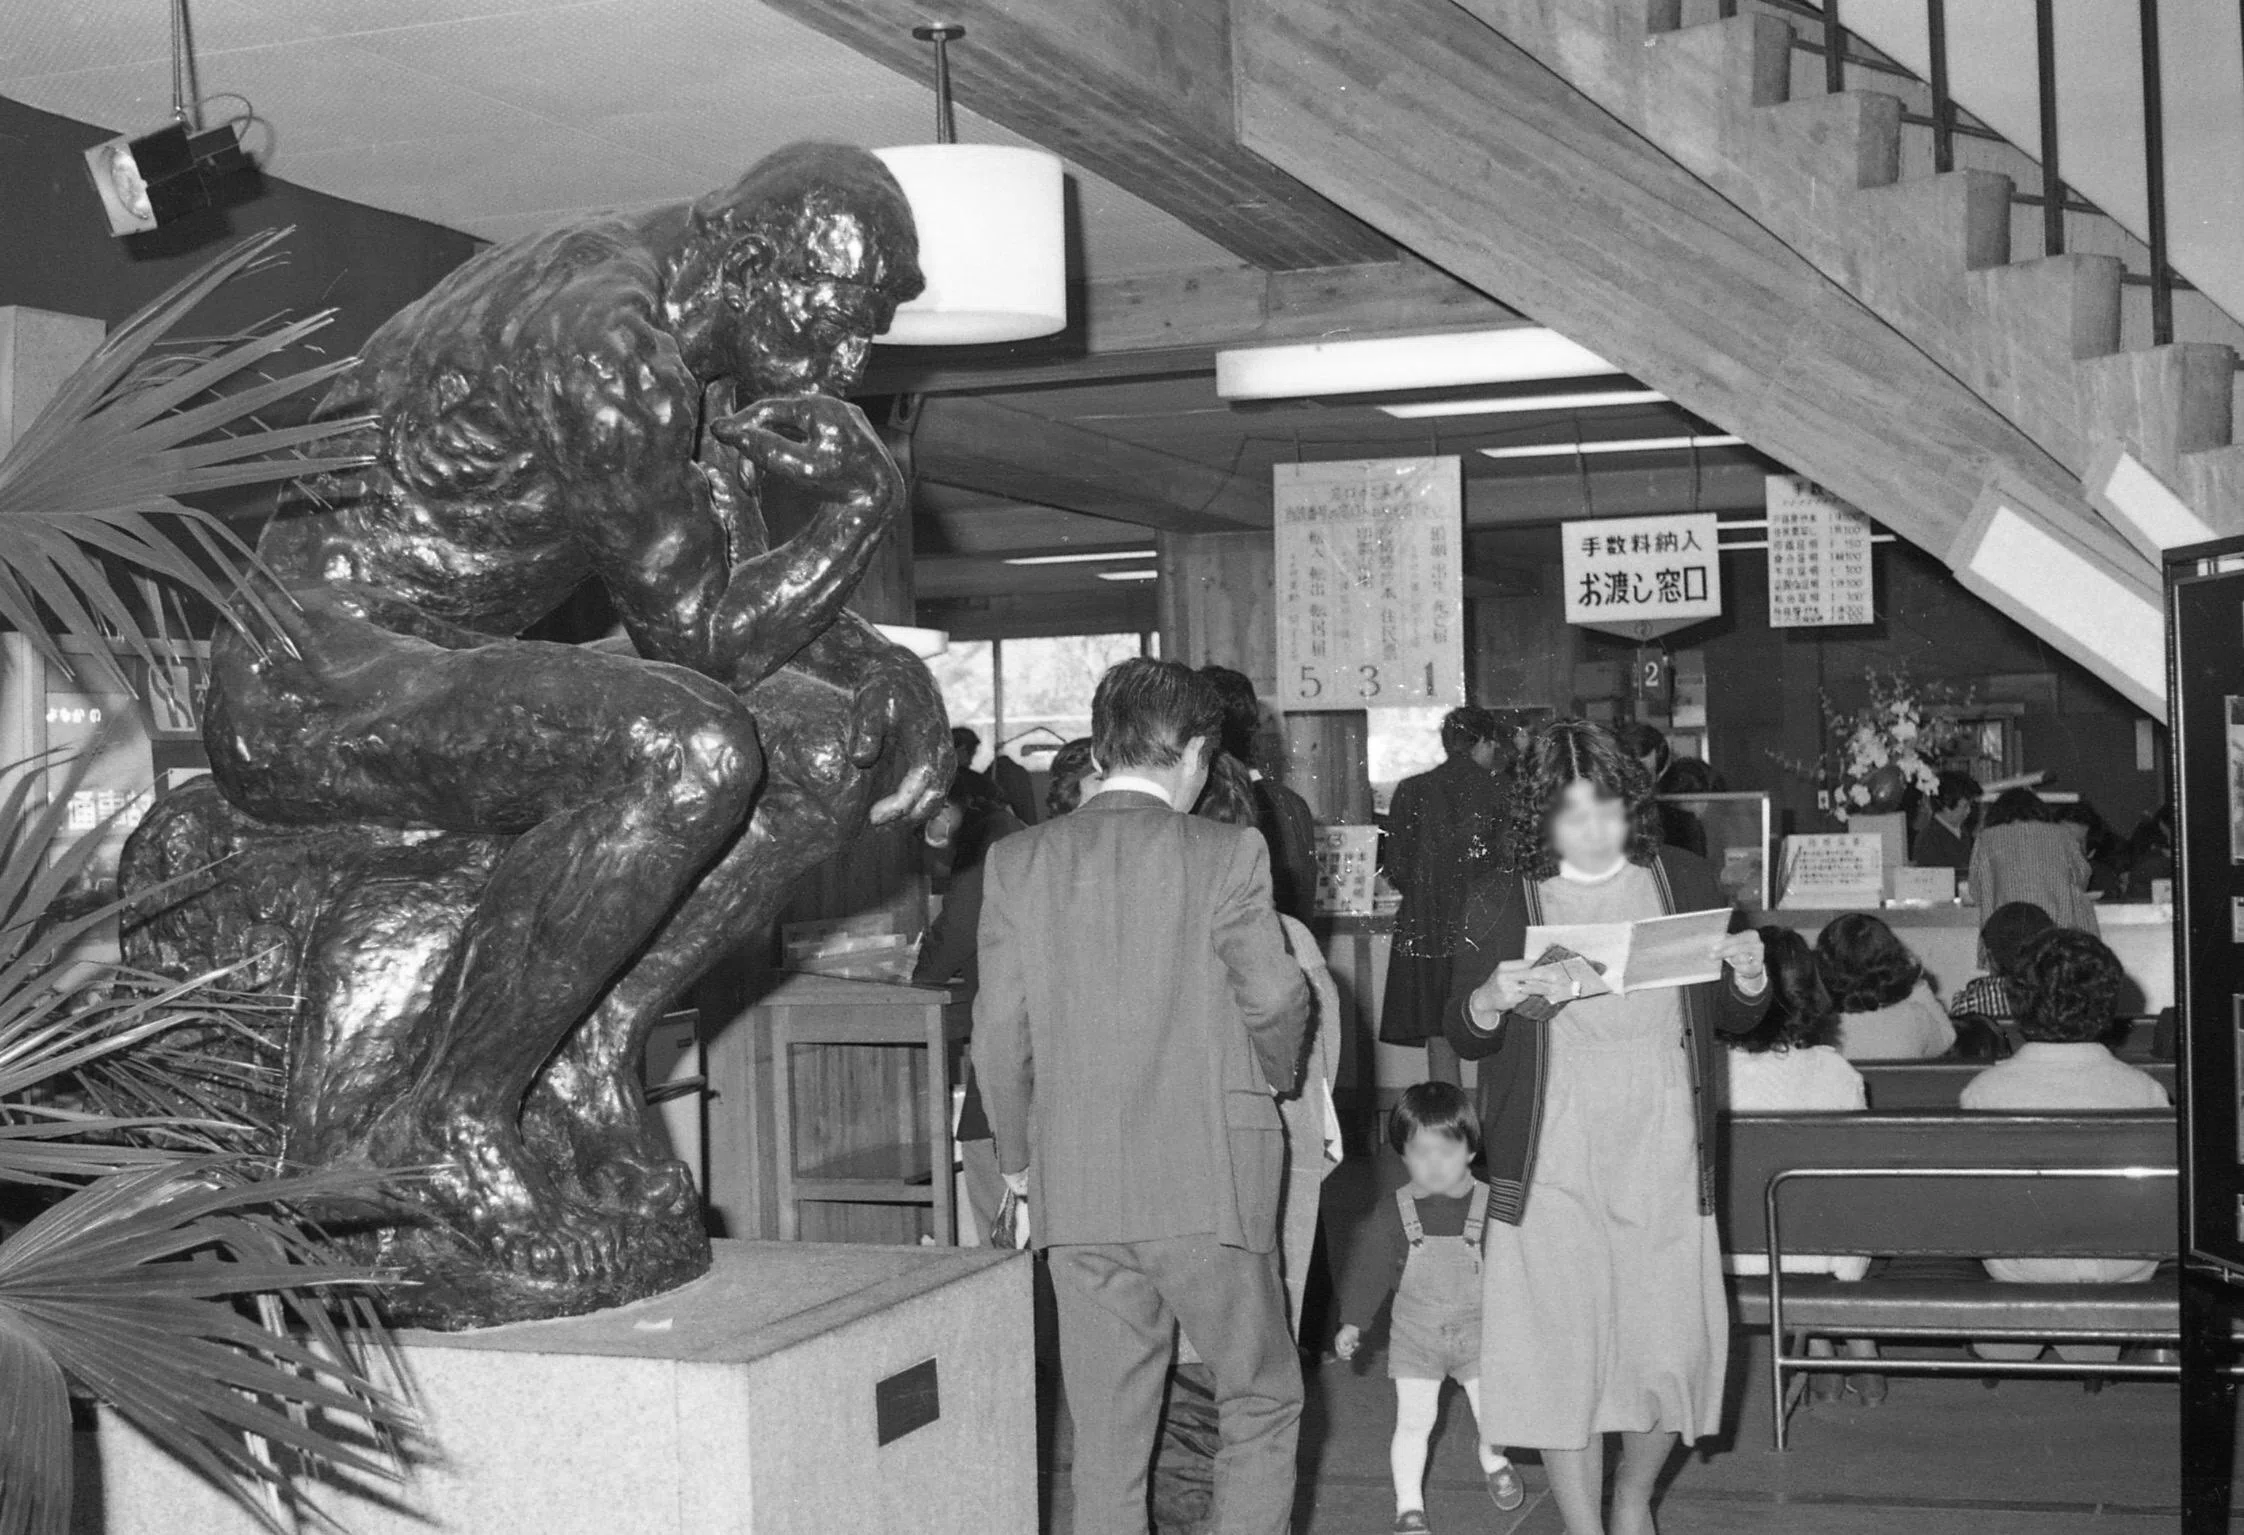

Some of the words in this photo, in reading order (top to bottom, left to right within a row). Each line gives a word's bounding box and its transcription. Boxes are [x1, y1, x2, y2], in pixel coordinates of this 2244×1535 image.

[1581, 529, 1703, 557] 手数料納入
[1578, 566, 1709, 607] お渡し窓口
[1300, 666, 1322, 698] 5
[1359, 665, 1381, 698] 3
[1424, 660, 1438, 697] 1
[1645, 661, 1659, 687] 2
